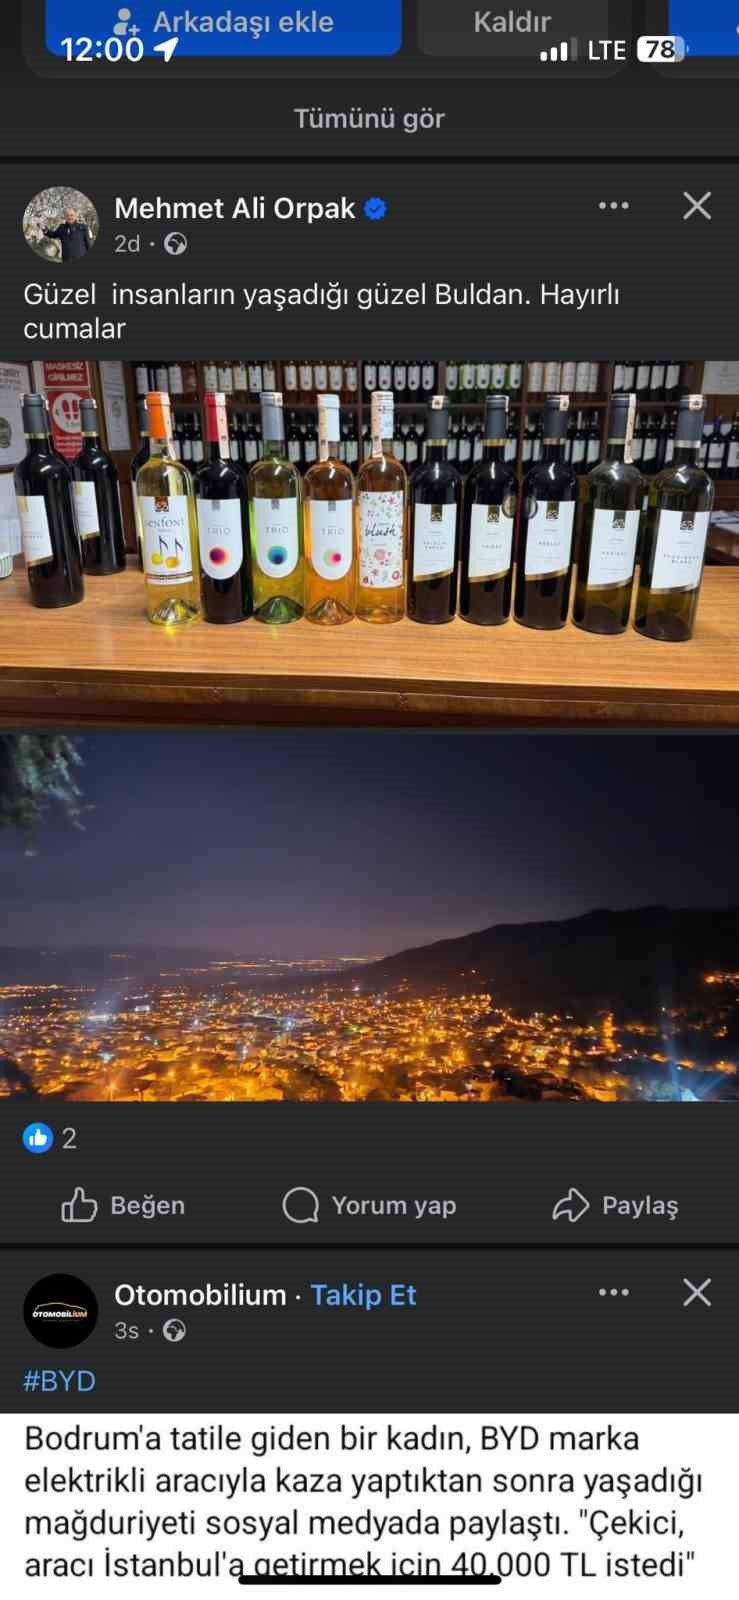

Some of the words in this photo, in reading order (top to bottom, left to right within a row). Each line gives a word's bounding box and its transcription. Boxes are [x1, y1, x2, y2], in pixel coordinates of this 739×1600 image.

[154, 10, 269, 38] Arkadaşı
[279, 9, 333, 32] ekle
[475, 11, 551, 32] Kaldır
[60, 38, 144, 62] 12:00
[589, 40, 626, 60] LTE
[645, 39, 675, 59] 78
[294, 107, 394, 128] Tümünü
[404, 108, 445, 133] gör
[116, 197, 224, 219] Mehmet
[232, 196, 264, 218] Ali
[274, 196, 356, 223] Orpak
[115, 235, 139, 252] 2d
[24, 283, 95, 305] Güzel
[113, 282, 234, 304] insanların
[243, 282, 348, 311] yaşadığı
[357, 282, 425, 309] güzel
[436, 283, 530, 304] Buldan.
[542, 282, 618, 310] Hayırlı
[24, 317, 126, 339] cumalar
[63, 1128, 76, 1148] 2
[112, 1195, 184, 1219] Beğen
[332, 1196, 406, 1214] Yorum
[414, 1200, 456, 1219] yap
[604, 1195, 678, 1220] Paylaş
[115, 1283, 286, 1306] Otomobilium
[311, 1283, 381, 1312] Takip
[391, 1284, 416, 1307] Et
[115, 1322, 138, 1339] 3s
[24, 1370, 95, 1391] #BYD
[26, 1424, 160, 1450] Bodrum'a
[170, 1424, 241, 1450] tatile
[251, 1424, 330, 1457] giden
[341, 1424, 378, 1450] bir
[387, 1424, 471, 1454] kadın,
[482, 1425, 539, 1450] BYD
[550, 1424, 639, 1450] marka
[25, 1466, 144, 1493] elektrikli
[156, 1466, 266, 1499] aracıyla
[277, 1466, 342, 1492] kaza
[352, 1466, 482, 1499] yaptıktan
[493, 1474, 574, 1493] sonra
[584, 1466, 701, 1500] yaşadığı
[26, 1509, 195, 1542] mağduriyeti
[206, 1509, 298, 1542] sosyal
[309, 1509, 439, 1541] medyada
[450, 1509, 568, 1542] paylaştı.
[580, 1509, 683, 1541] "Çekici,
[25, 1558, 93, 1577] aracı
[104, 1548, 244, 1577] İstanbul'a
[450, 1552, 550, 1578] 40.000
[560, 1552, 597, 1577] TL
[607, 1551, 694, 1577] istedi"
